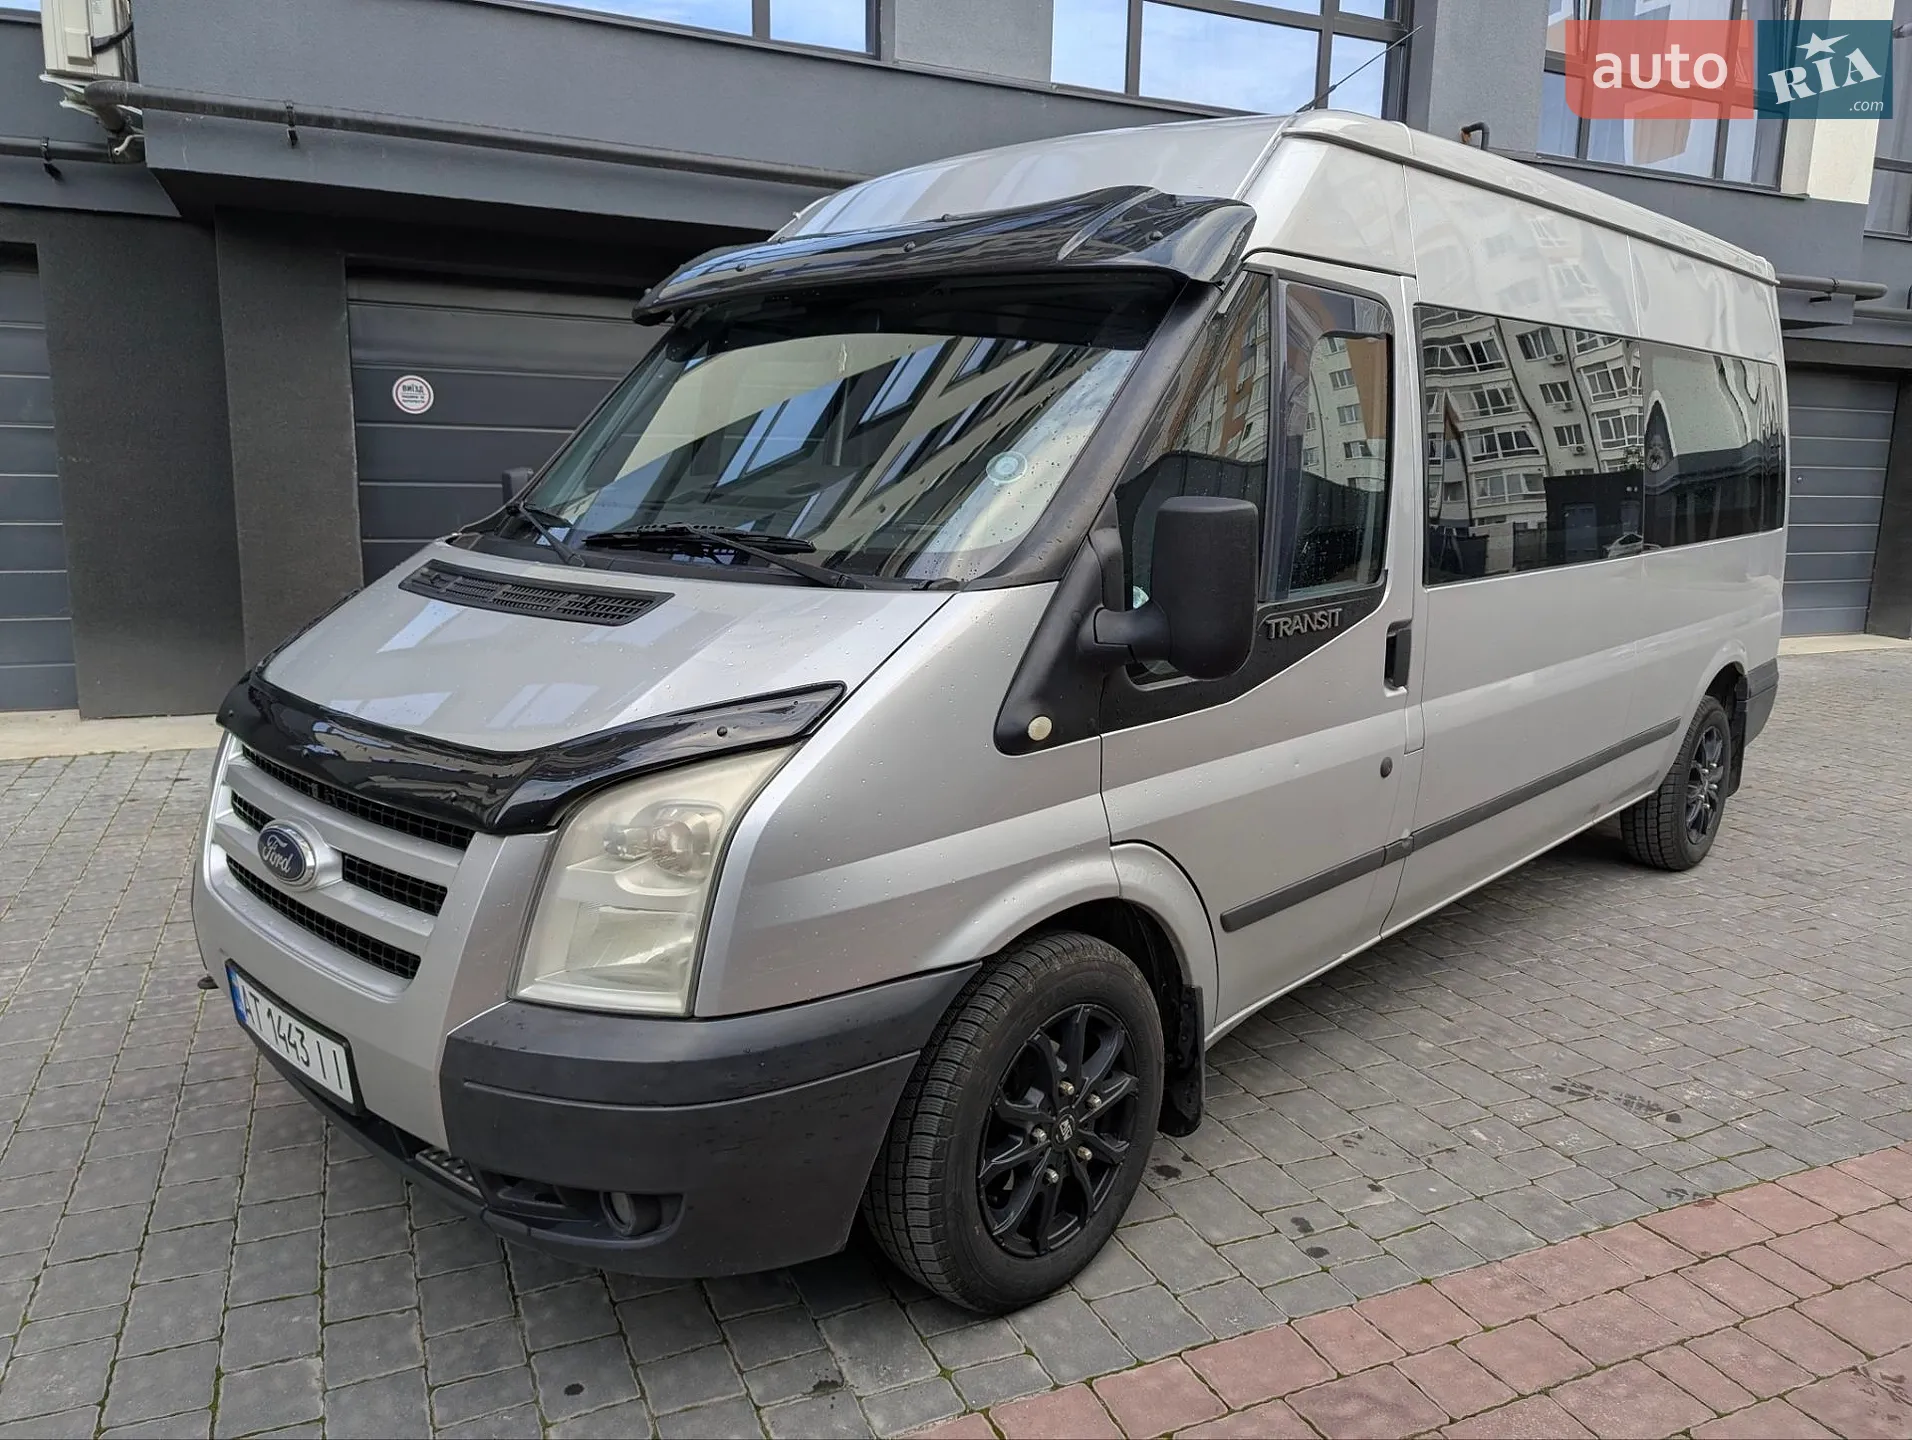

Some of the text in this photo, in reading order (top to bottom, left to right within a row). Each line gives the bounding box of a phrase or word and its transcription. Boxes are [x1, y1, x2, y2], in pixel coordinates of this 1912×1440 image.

[1266, 608, 1342, 639] TRANSIT
[262, 834, 294, 873] Ford
[241, 985, 343, 1091] AT 1443 II
